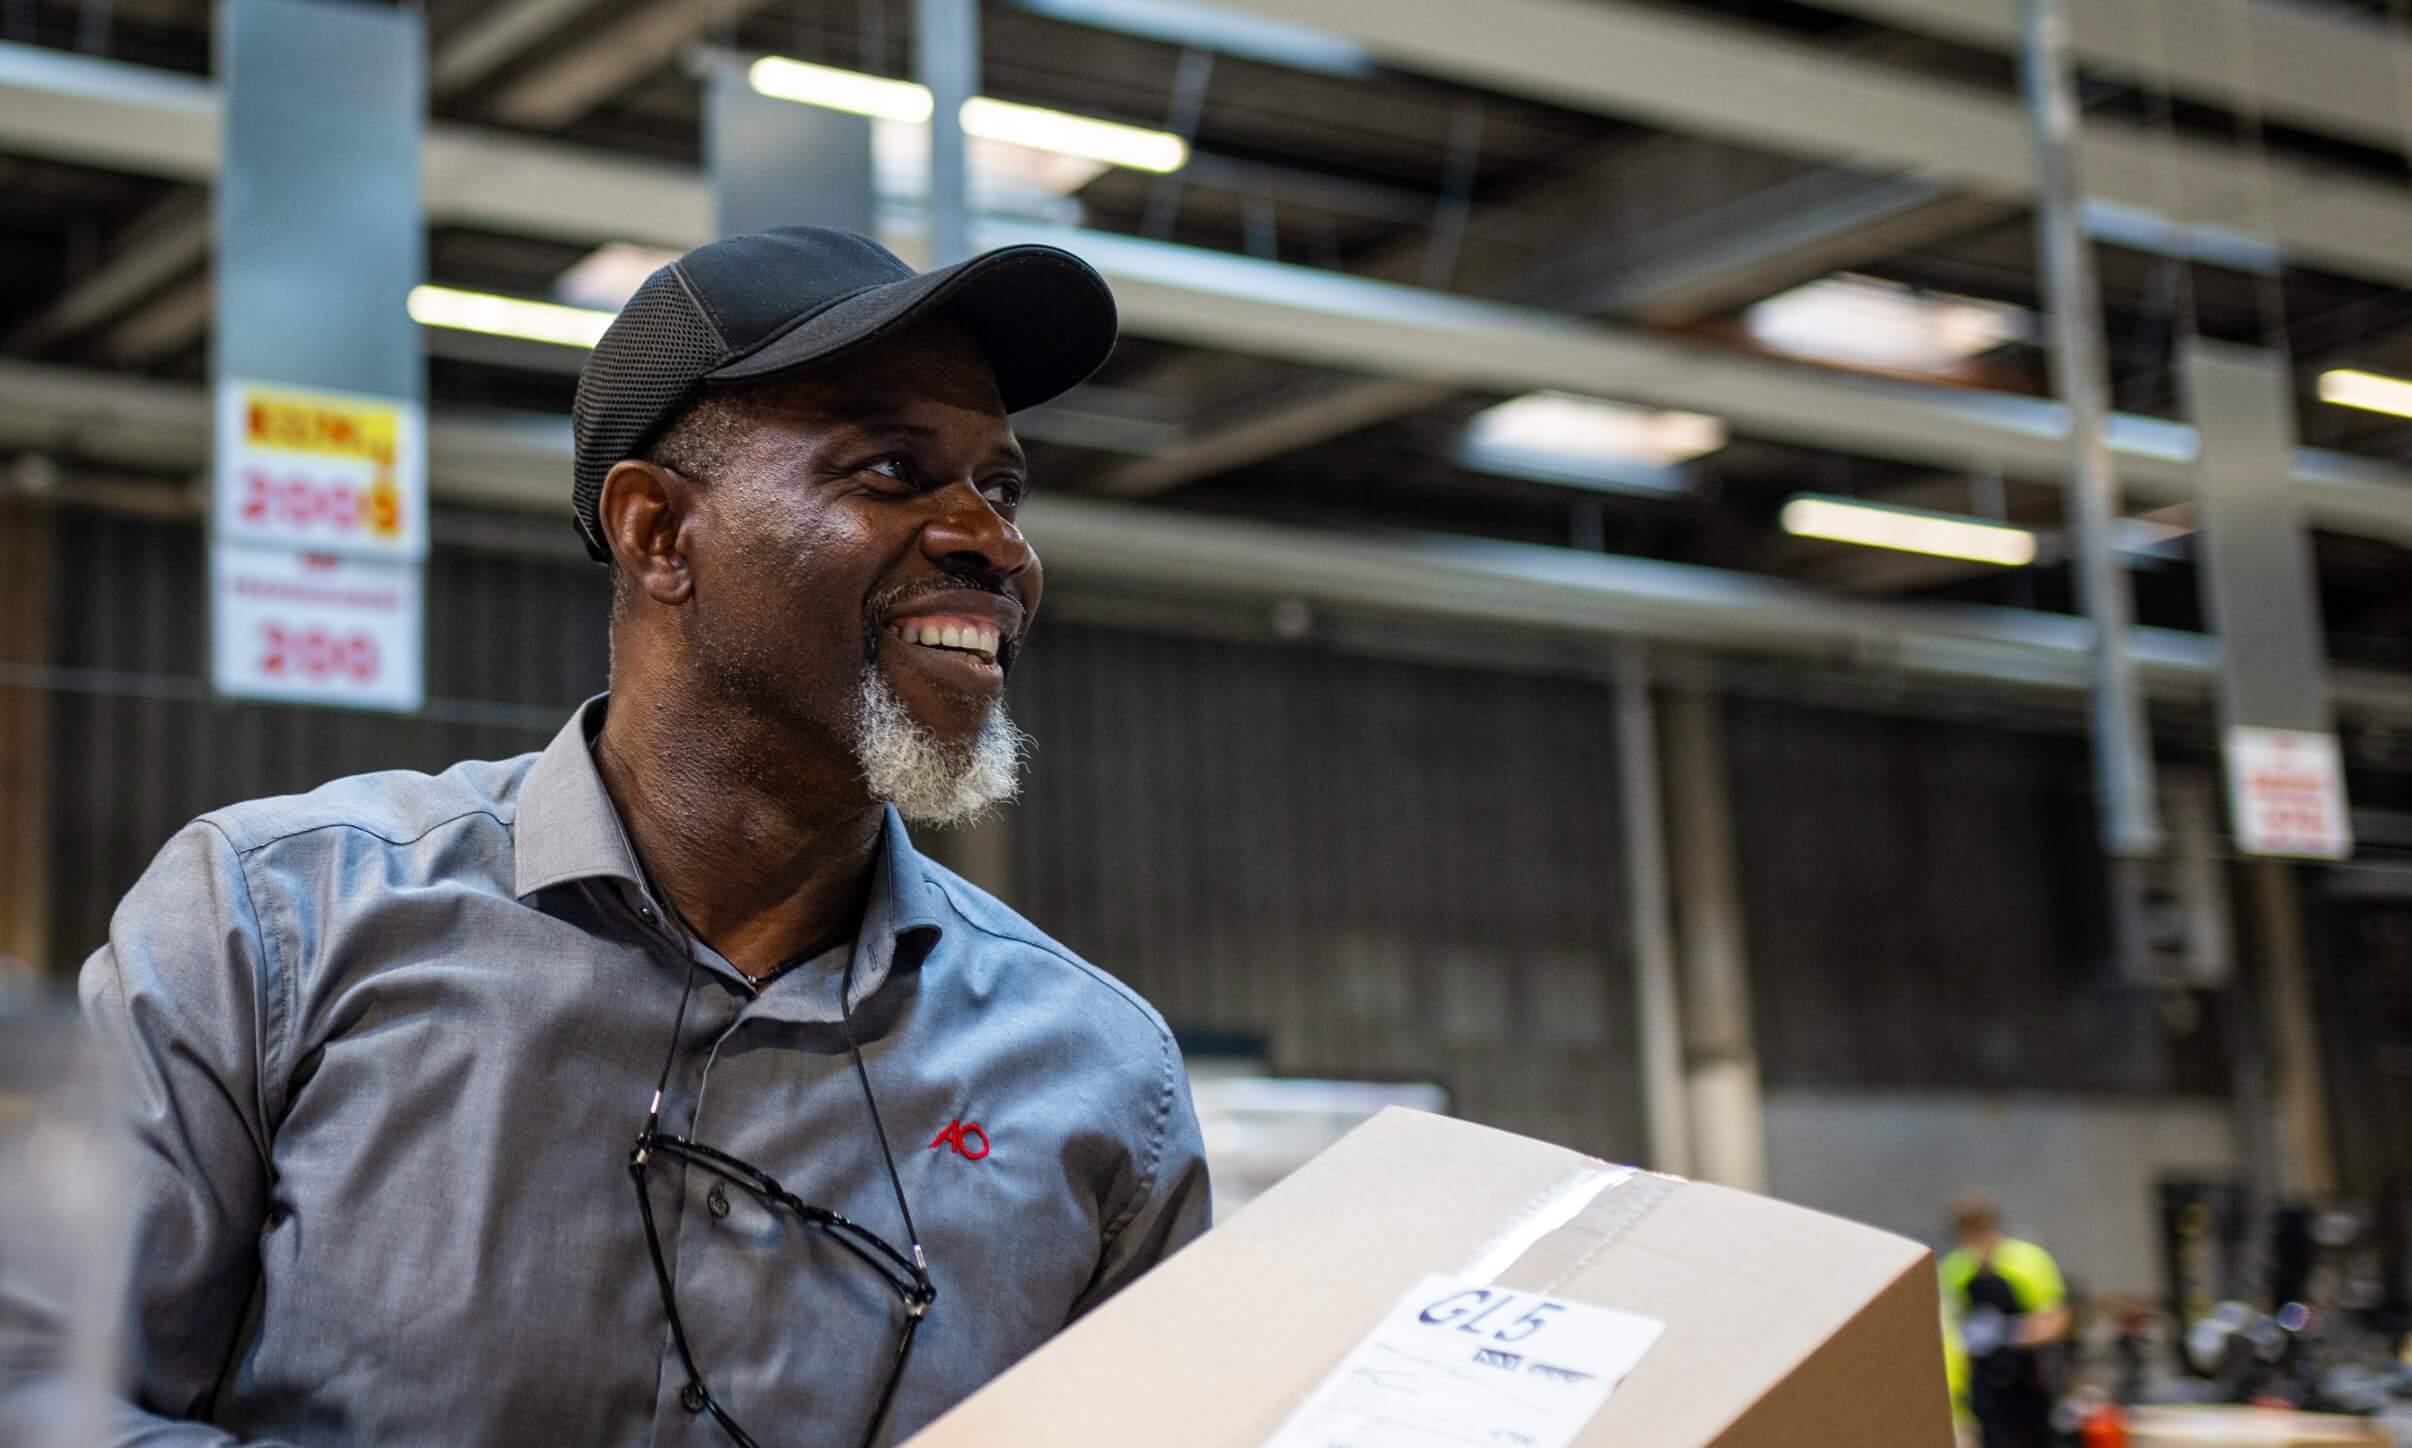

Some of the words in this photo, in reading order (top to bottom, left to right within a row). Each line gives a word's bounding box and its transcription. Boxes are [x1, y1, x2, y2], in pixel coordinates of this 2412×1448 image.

[258, 619, 378, 686] 200
[928, 1119, 990, 1160] AO
[1417, 1289, 1569, 1342] GL5
